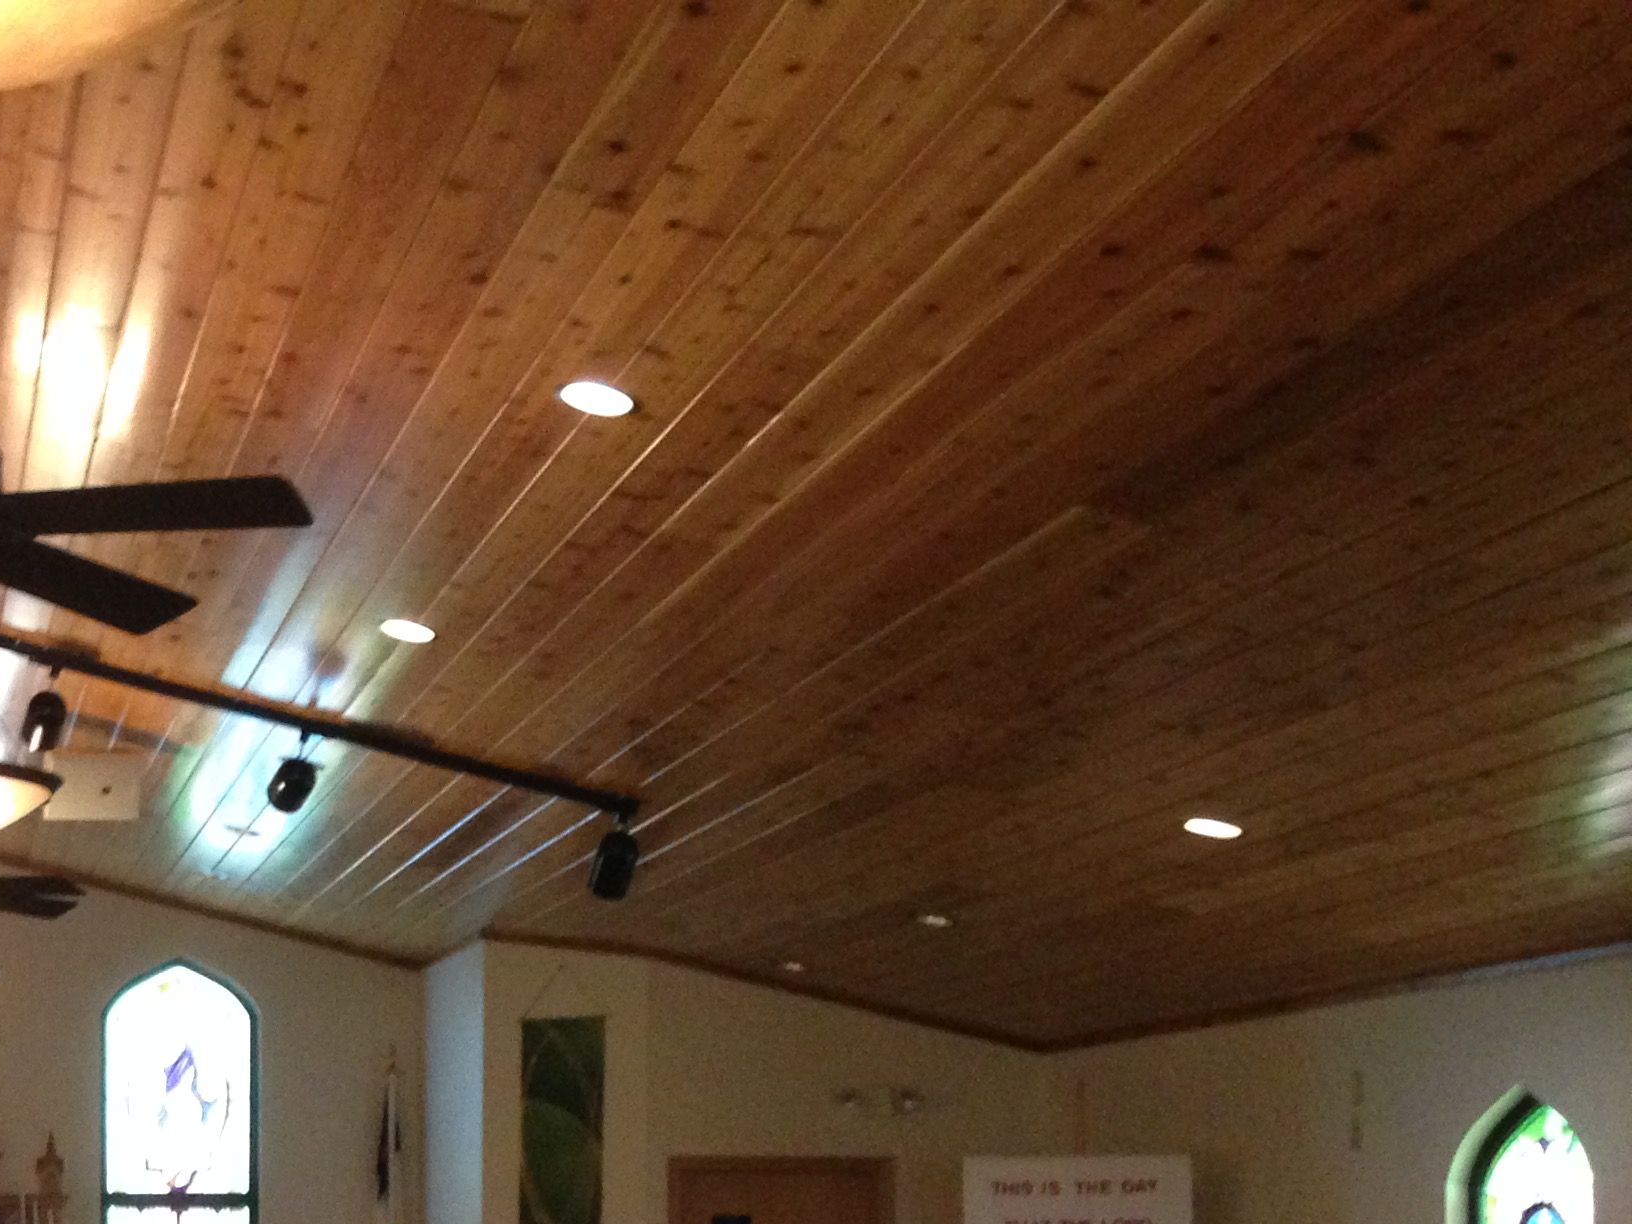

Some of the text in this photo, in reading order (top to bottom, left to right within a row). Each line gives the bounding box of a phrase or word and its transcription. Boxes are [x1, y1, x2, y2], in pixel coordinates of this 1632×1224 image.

[990, 1178, 1157, 1196] THIS IS THE DAY
